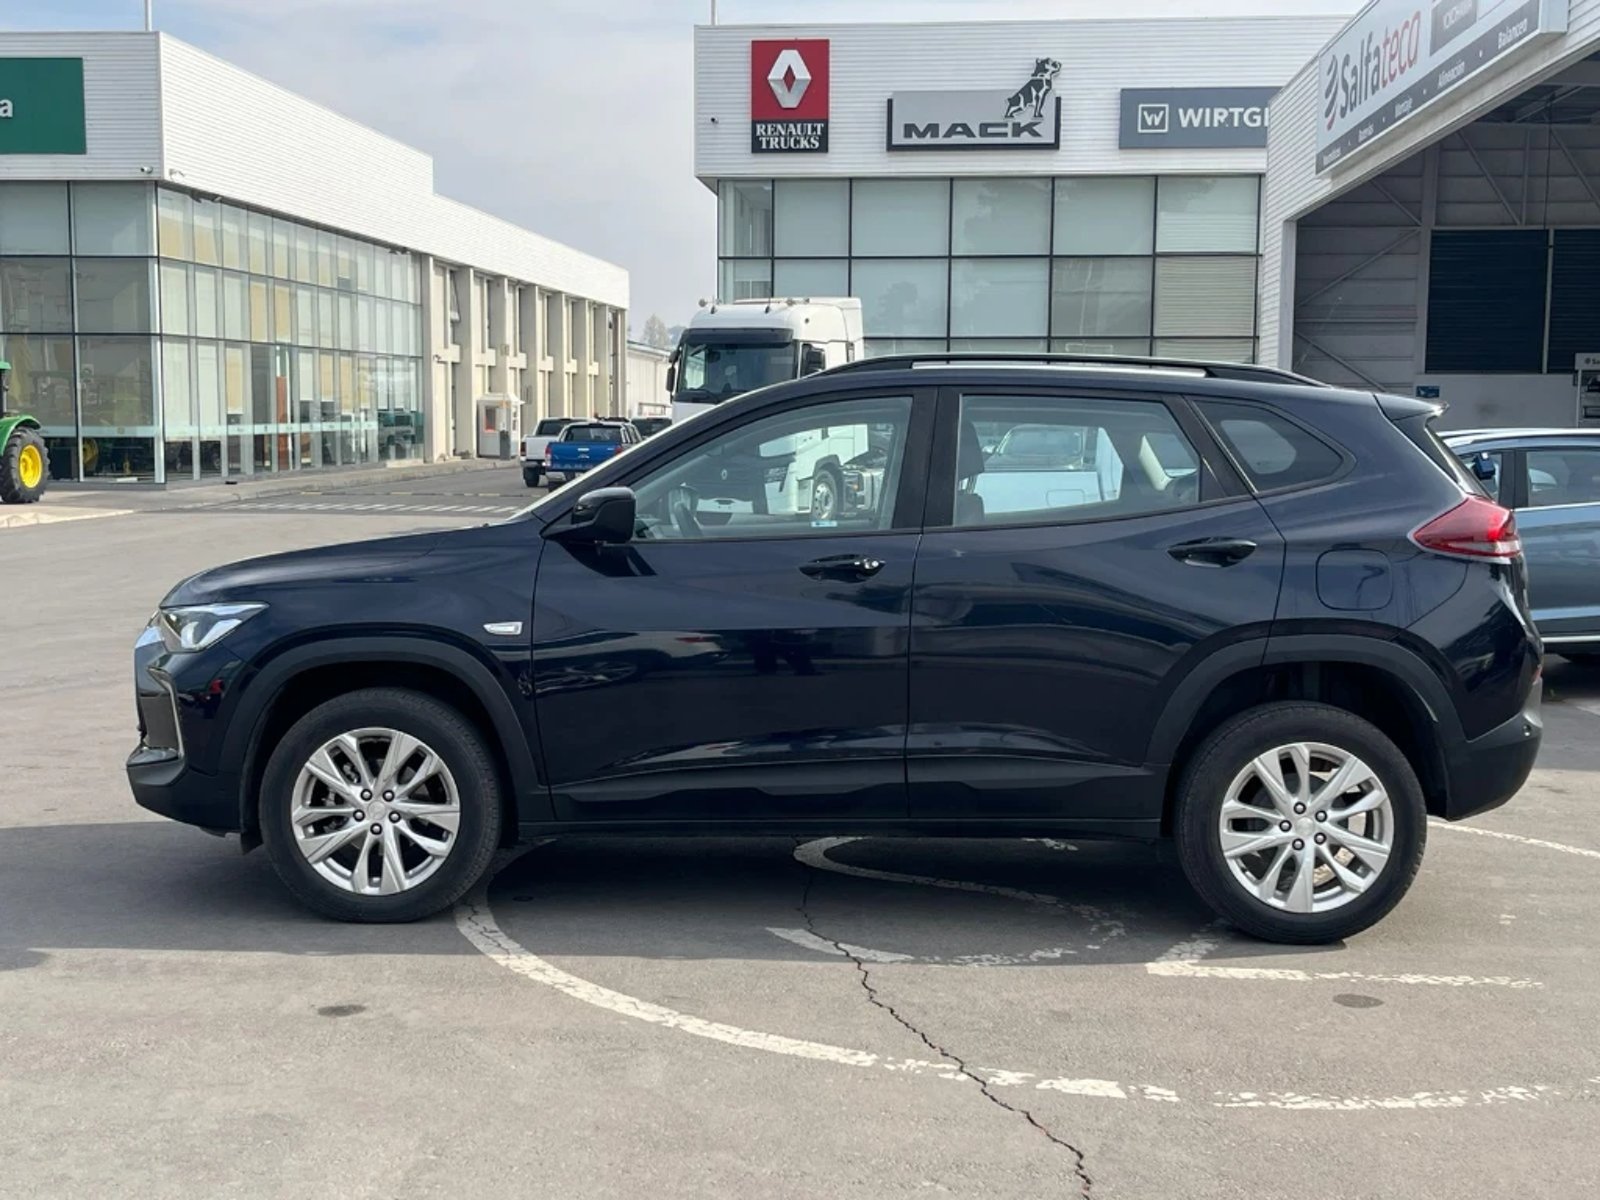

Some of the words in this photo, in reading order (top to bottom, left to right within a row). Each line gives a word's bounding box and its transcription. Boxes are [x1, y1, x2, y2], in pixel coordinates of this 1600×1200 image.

[756, 123, 824, 136] RENAULT
[903, 122, 1043, 138] MACK
[759, 136, 820, 149] TRUCKS
